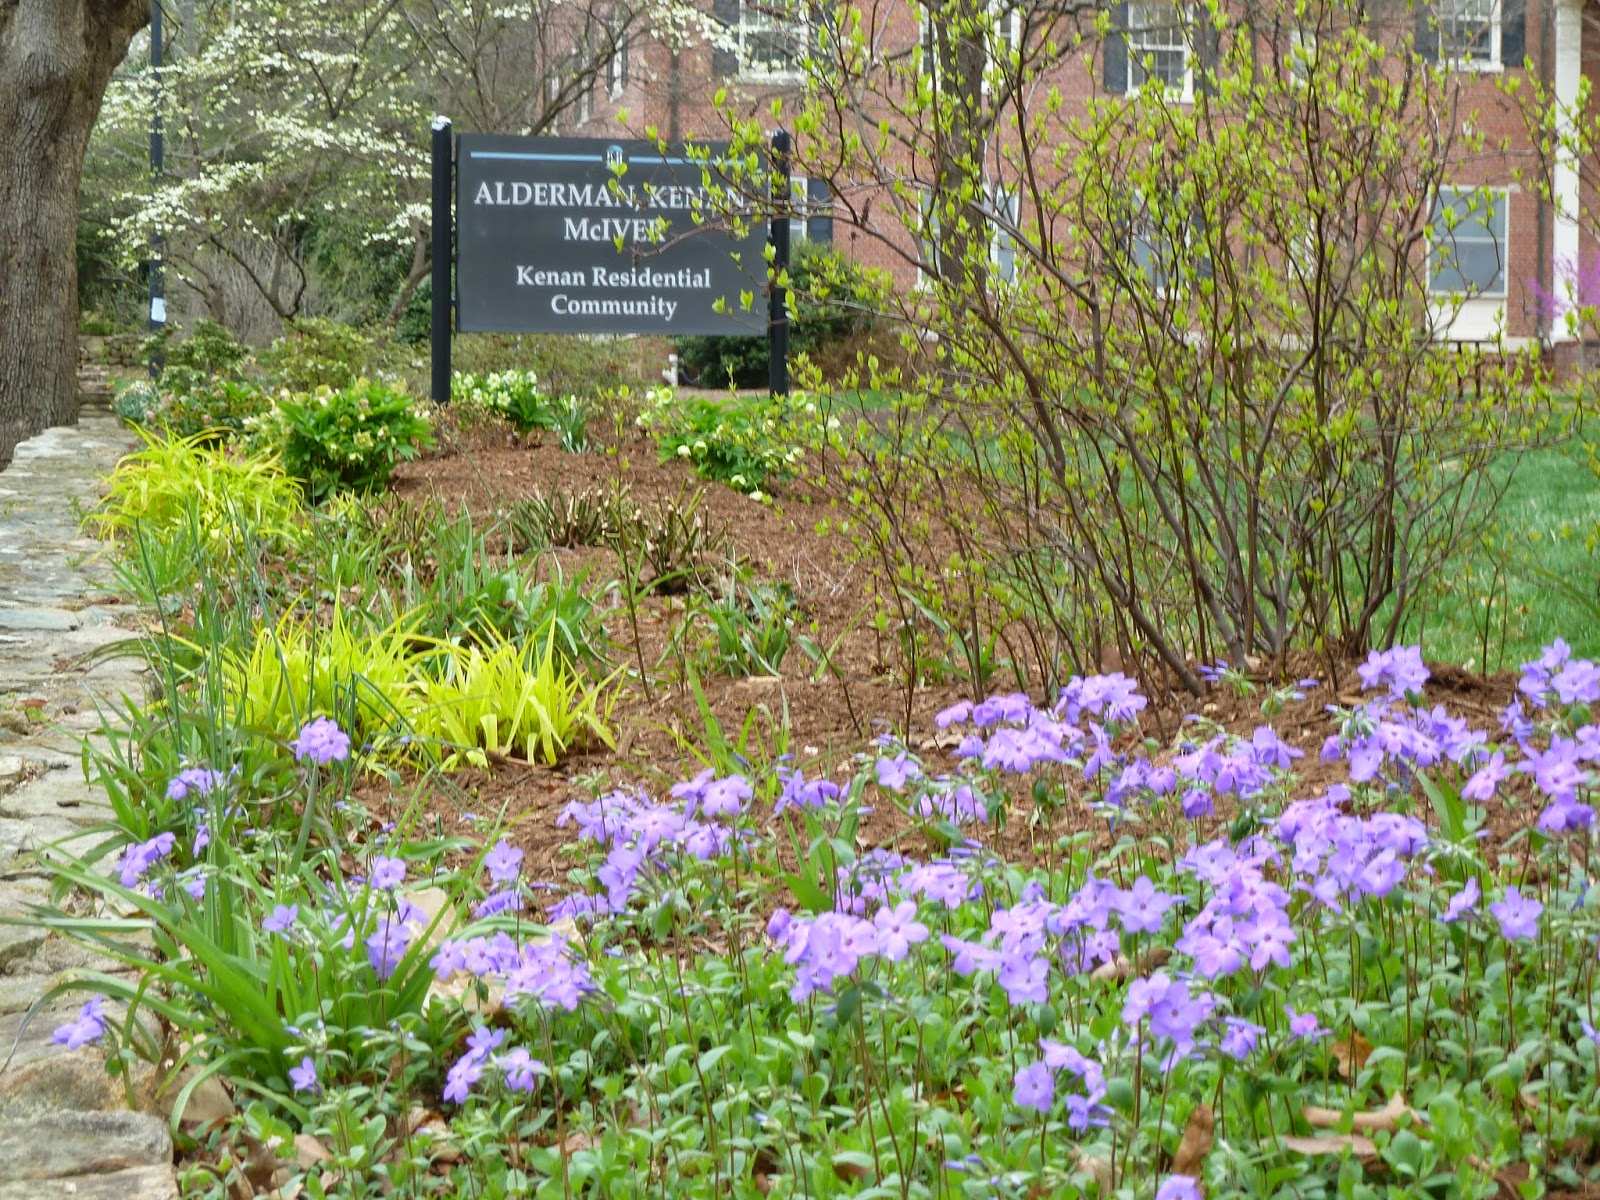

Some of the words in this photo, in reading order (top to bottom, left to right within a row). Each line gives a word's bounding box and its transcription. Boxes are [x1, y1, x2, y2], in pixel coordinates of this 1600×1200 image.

[473, 181, 641, 213] ALDERMAN,
[516, 265, 586, 287] Kenan
[592, 266, 711, 289] Residential
[550, 293, 678, 322] Community
